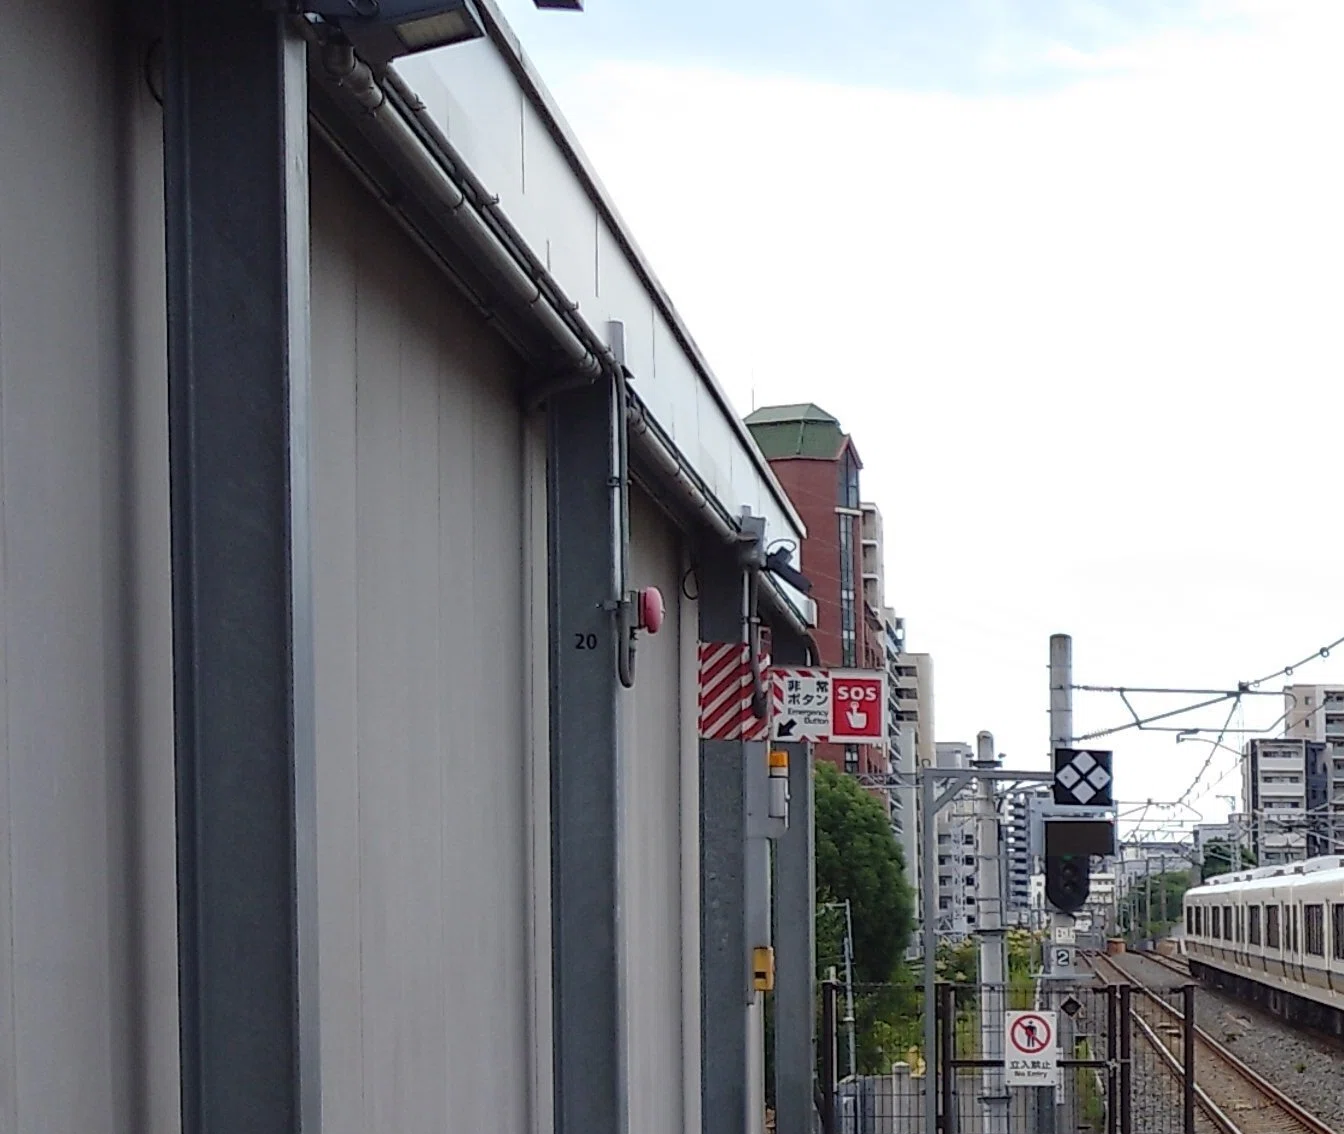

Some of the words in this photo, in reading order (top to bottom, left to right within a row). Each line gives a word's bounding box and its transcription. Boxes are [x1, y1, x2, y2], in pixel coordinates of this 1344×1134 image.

[575, 633, 597, 650] 20
[787, 680, 829, 692] 非常
[788, 693, 829, 705] ボタン
[837, 685, 877, 701] SOS
[787, 708, 829, 716] Emergency
[804, 717, 829, 725] Button
[1058, 950, 1069, 966] 2
[1010, 1061, 1051, 1070] 立入禁止
[1027, 1070, 1048, 1079] Entry
